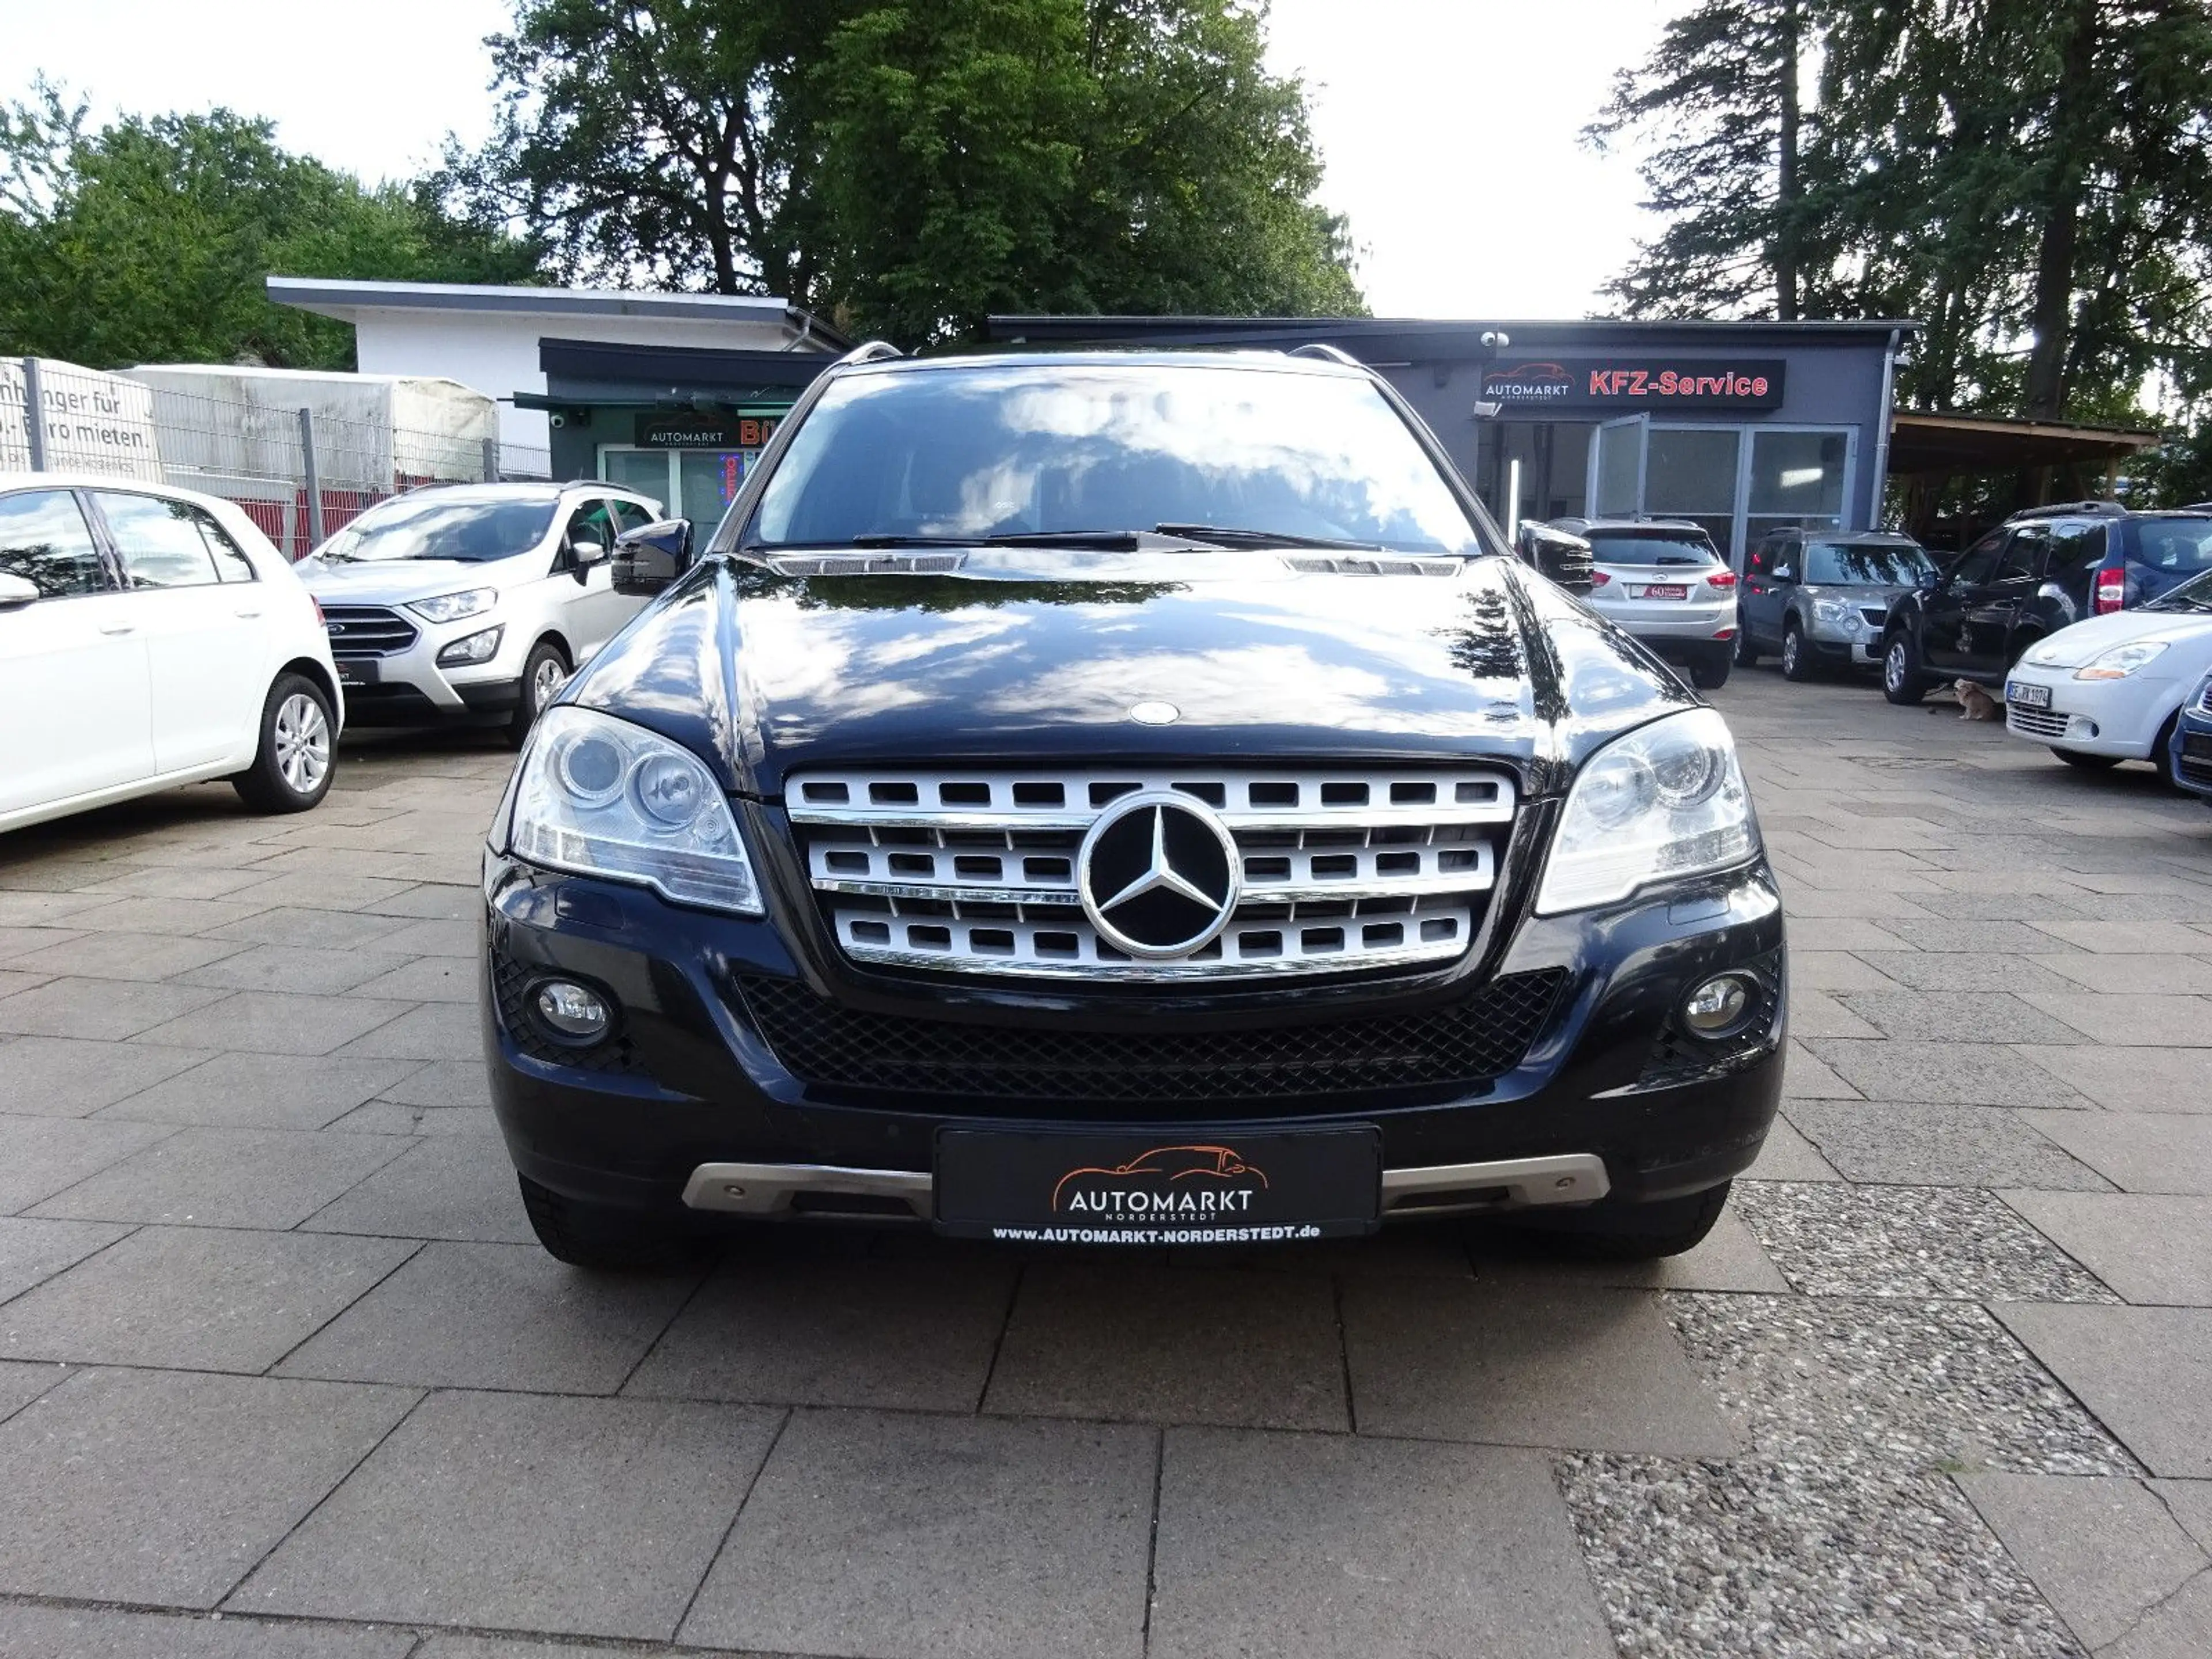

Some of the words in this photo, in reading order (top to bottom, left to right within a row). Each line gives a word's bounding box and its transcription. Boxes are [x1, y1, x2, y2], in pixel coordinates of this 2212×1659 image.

[1485, 385, 1569, 395] AUTOMARKT
[1589, 370, 1768, 396] KFZ-Service
[93, 391, 120, 414] für
[75, 422, 149, 449] mieten.
[651, 433, 723, 442] AUTOMARKT
[1652, 586, 1664, 597] 60
[1069, 1190, 1253, 1211] AUTOMARKT
[1105, 1213, 1216, 1221] NORDERSTEDT
[993, 1225, 1321, 1243] www.AUTOMARKT-NORDERSTEDT.de
